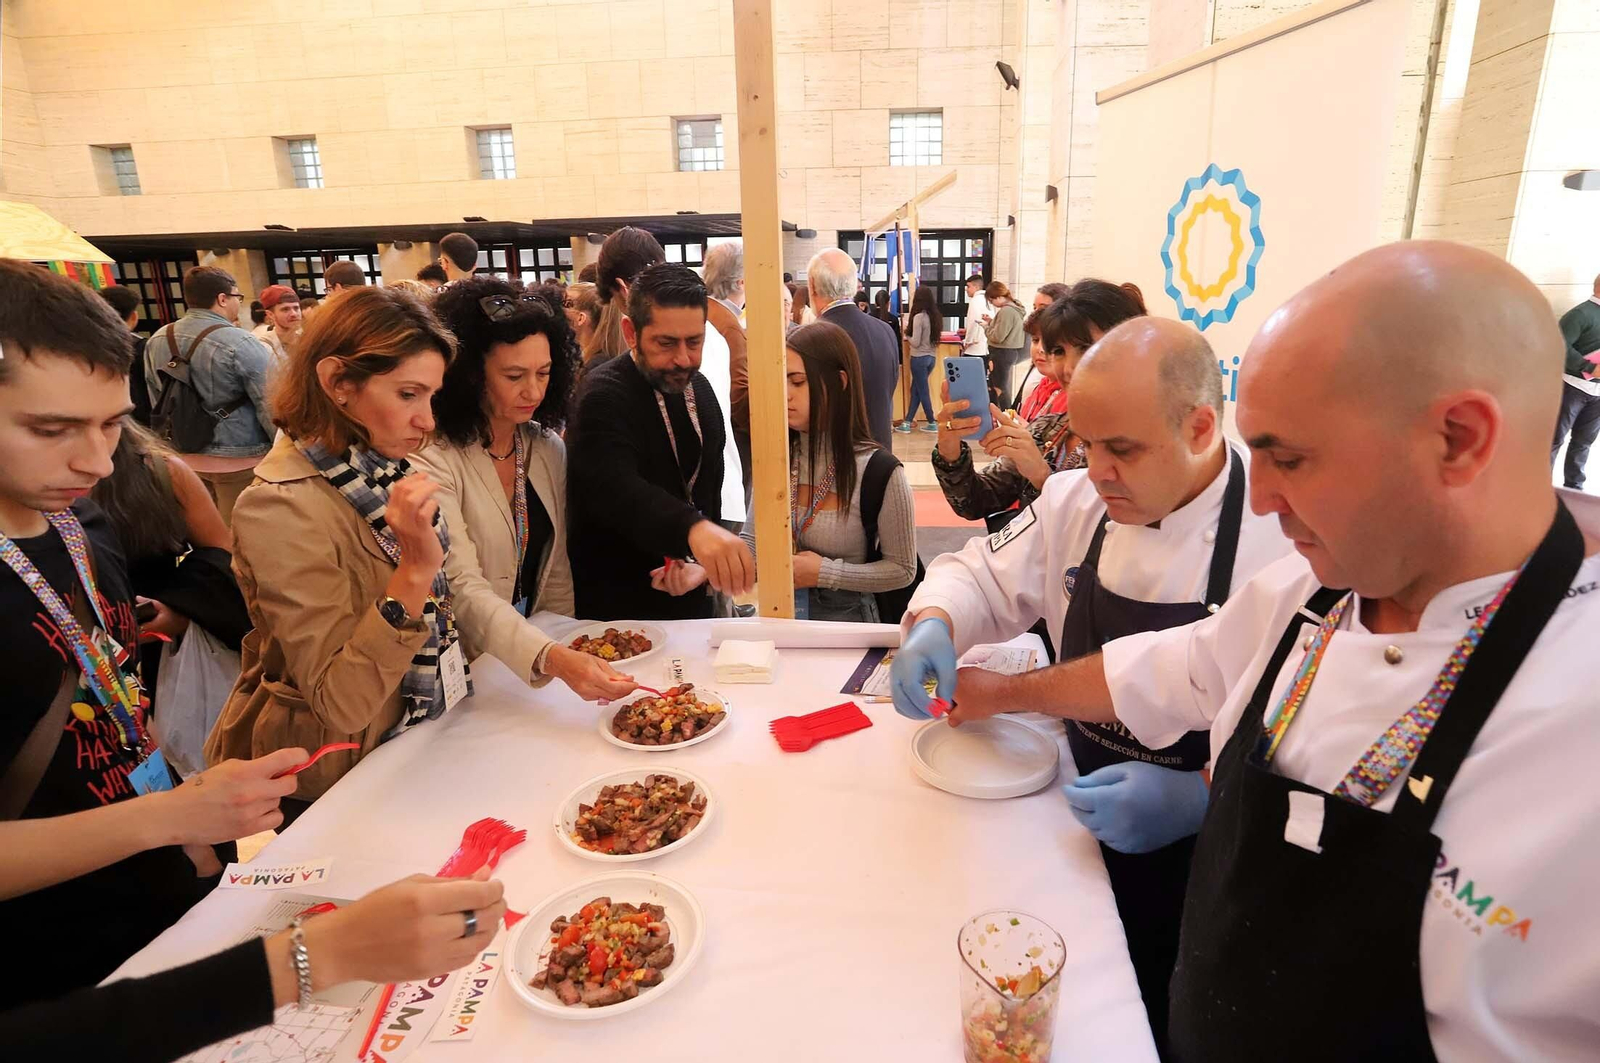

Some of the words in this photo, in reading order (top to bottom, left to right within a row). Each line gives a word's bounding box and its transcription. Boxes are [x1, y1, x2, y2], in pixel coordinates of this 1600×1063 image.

[1100, 739, 1139, 759] SELECCIÓN
[1141, 752, 1152, 762] EN
[1153, 755, 1183, 764] CARNE
[229, 873, 295, 886] PAMPA
[302, 868, 325, 881] LA
[477, 952, 499, 974] LA
[449, 978, 489, 1037] PAMPA
